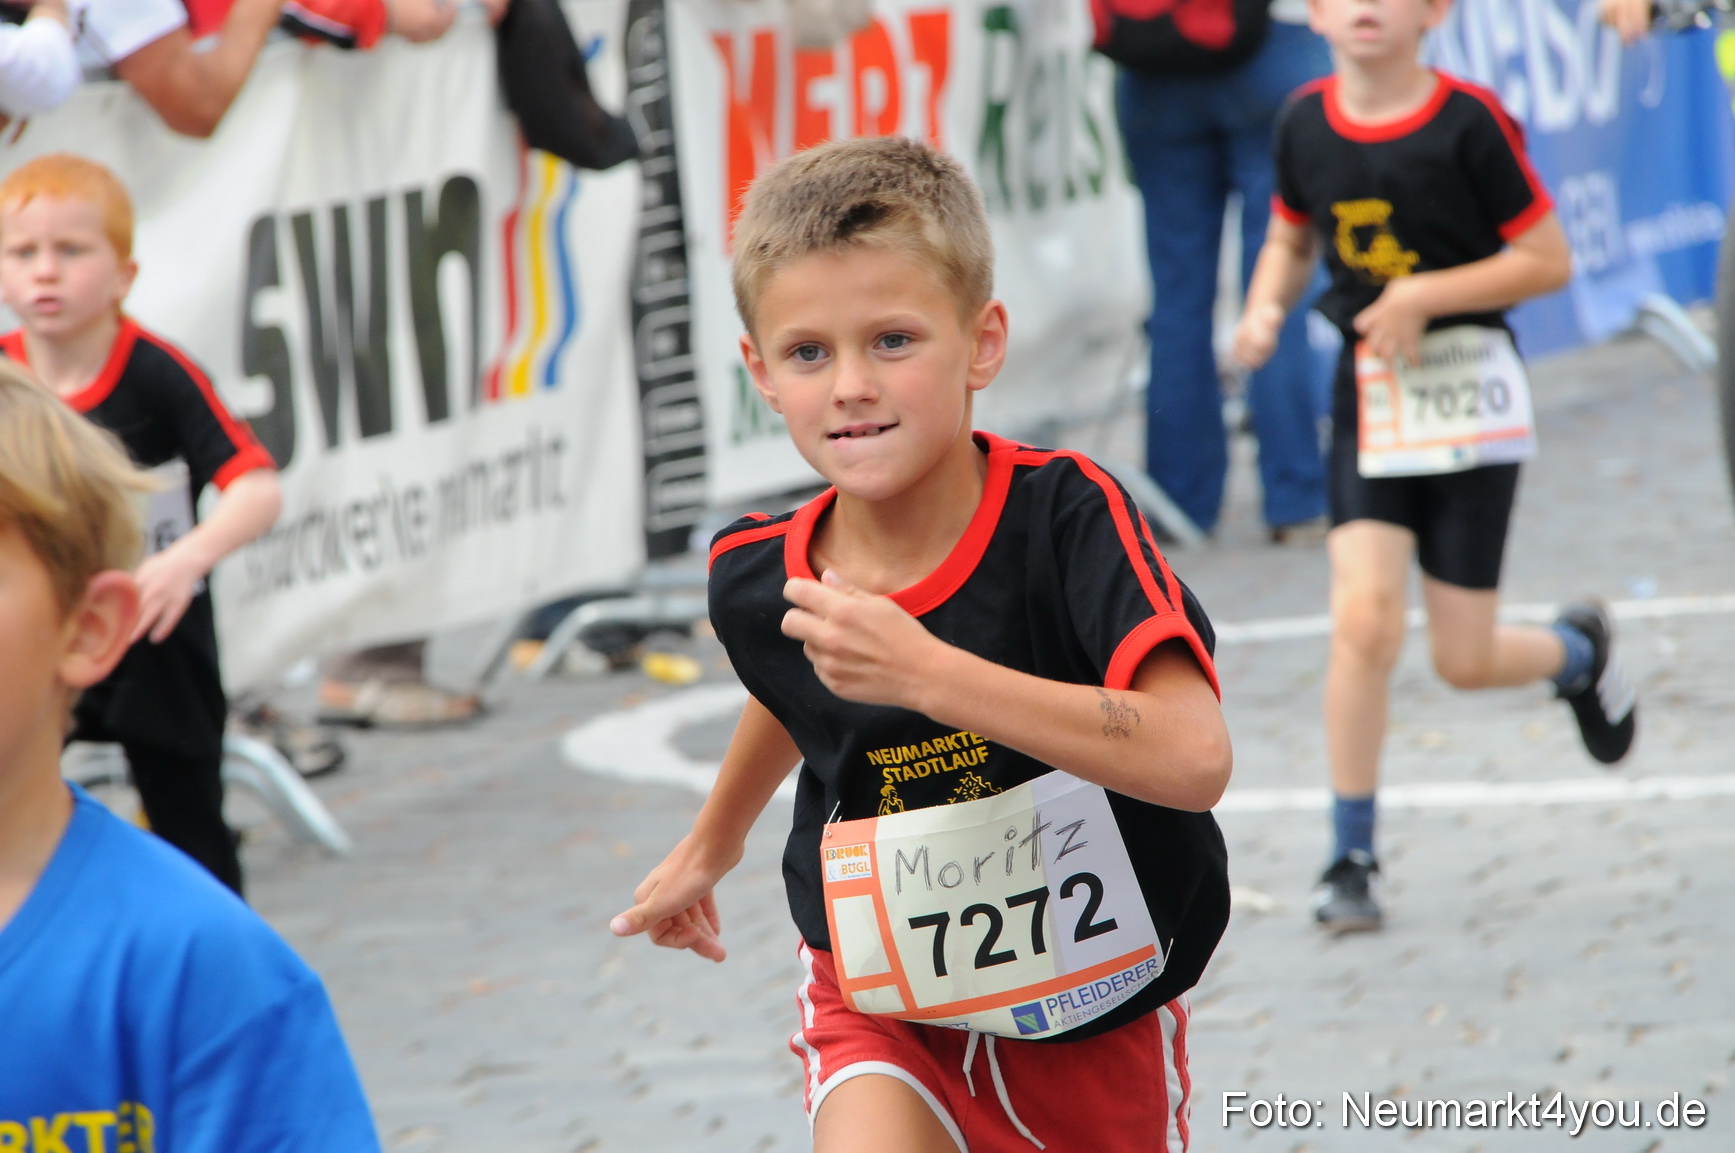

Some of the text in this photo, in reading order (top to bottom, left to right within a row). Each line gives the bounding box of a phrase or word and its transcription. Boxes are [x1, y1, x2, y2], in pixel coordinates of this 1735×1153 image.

[1410, 376, 1512, 423] 7020
[866, 730, 989, 766] NEUMARKTE
[882, 745, 990, 784] STADTLAUF
[894, 809, 1089, 896] Moritz
[907, 871, 1119, 978] 7272
[1045, 958, 1159, 1017] PFLEIDERER
